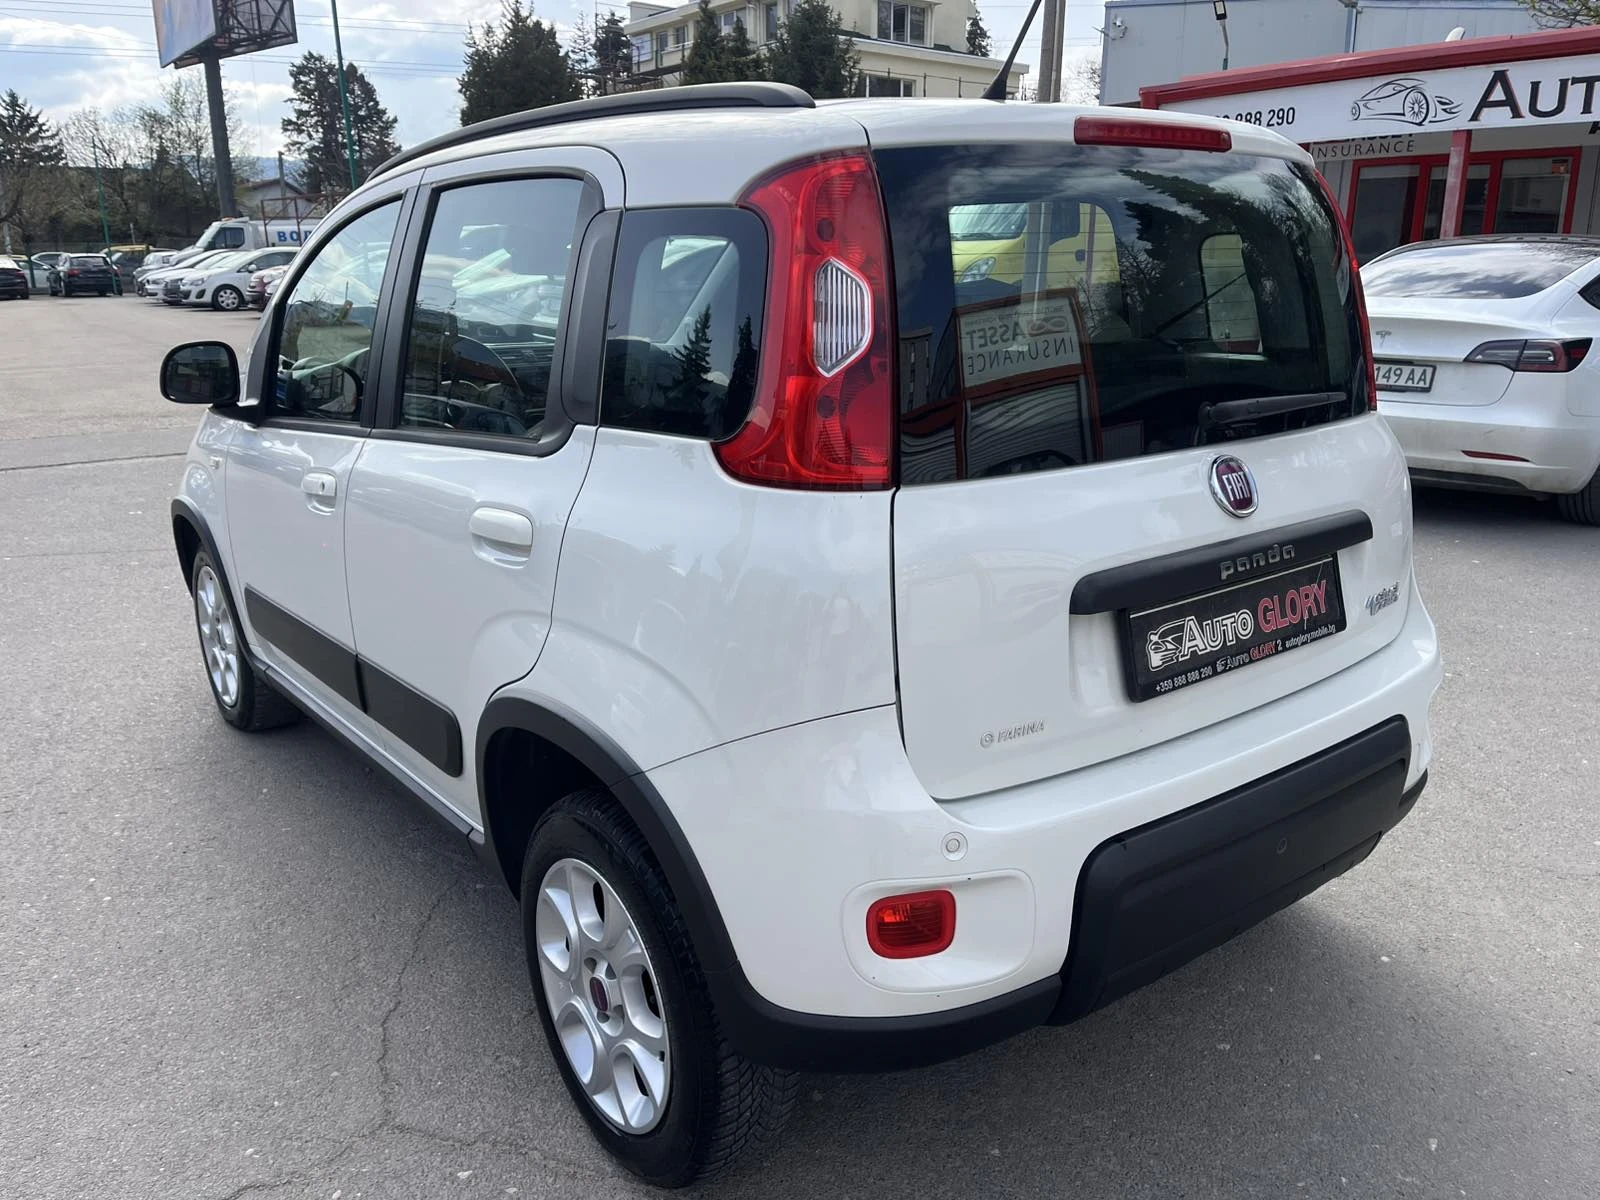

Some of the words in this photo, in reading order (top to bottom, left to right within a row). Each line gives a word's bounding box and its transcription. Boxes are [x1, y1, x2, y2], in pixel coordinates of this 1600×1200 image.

[1266, 107, 1296, 127] 290
[1310, 140, 1415, 158] INSURANCE
[1222, 471, 1250, 501] FIAT
[1220, 544, 1295, 580] panda
[1179, 608, 1254, 661] AUTO
[1258, 580, 1327, 633] GLORY
[1155, 679, 1173, 693] +359
[1173, 674, 1187, 688] 888
[1187, 670, 1200, 684] 888
[1200, 666, 1213, 680] 290
[1250, 640, 1276, 660] GLORY
[1276, 639, 1283, 651] 2
